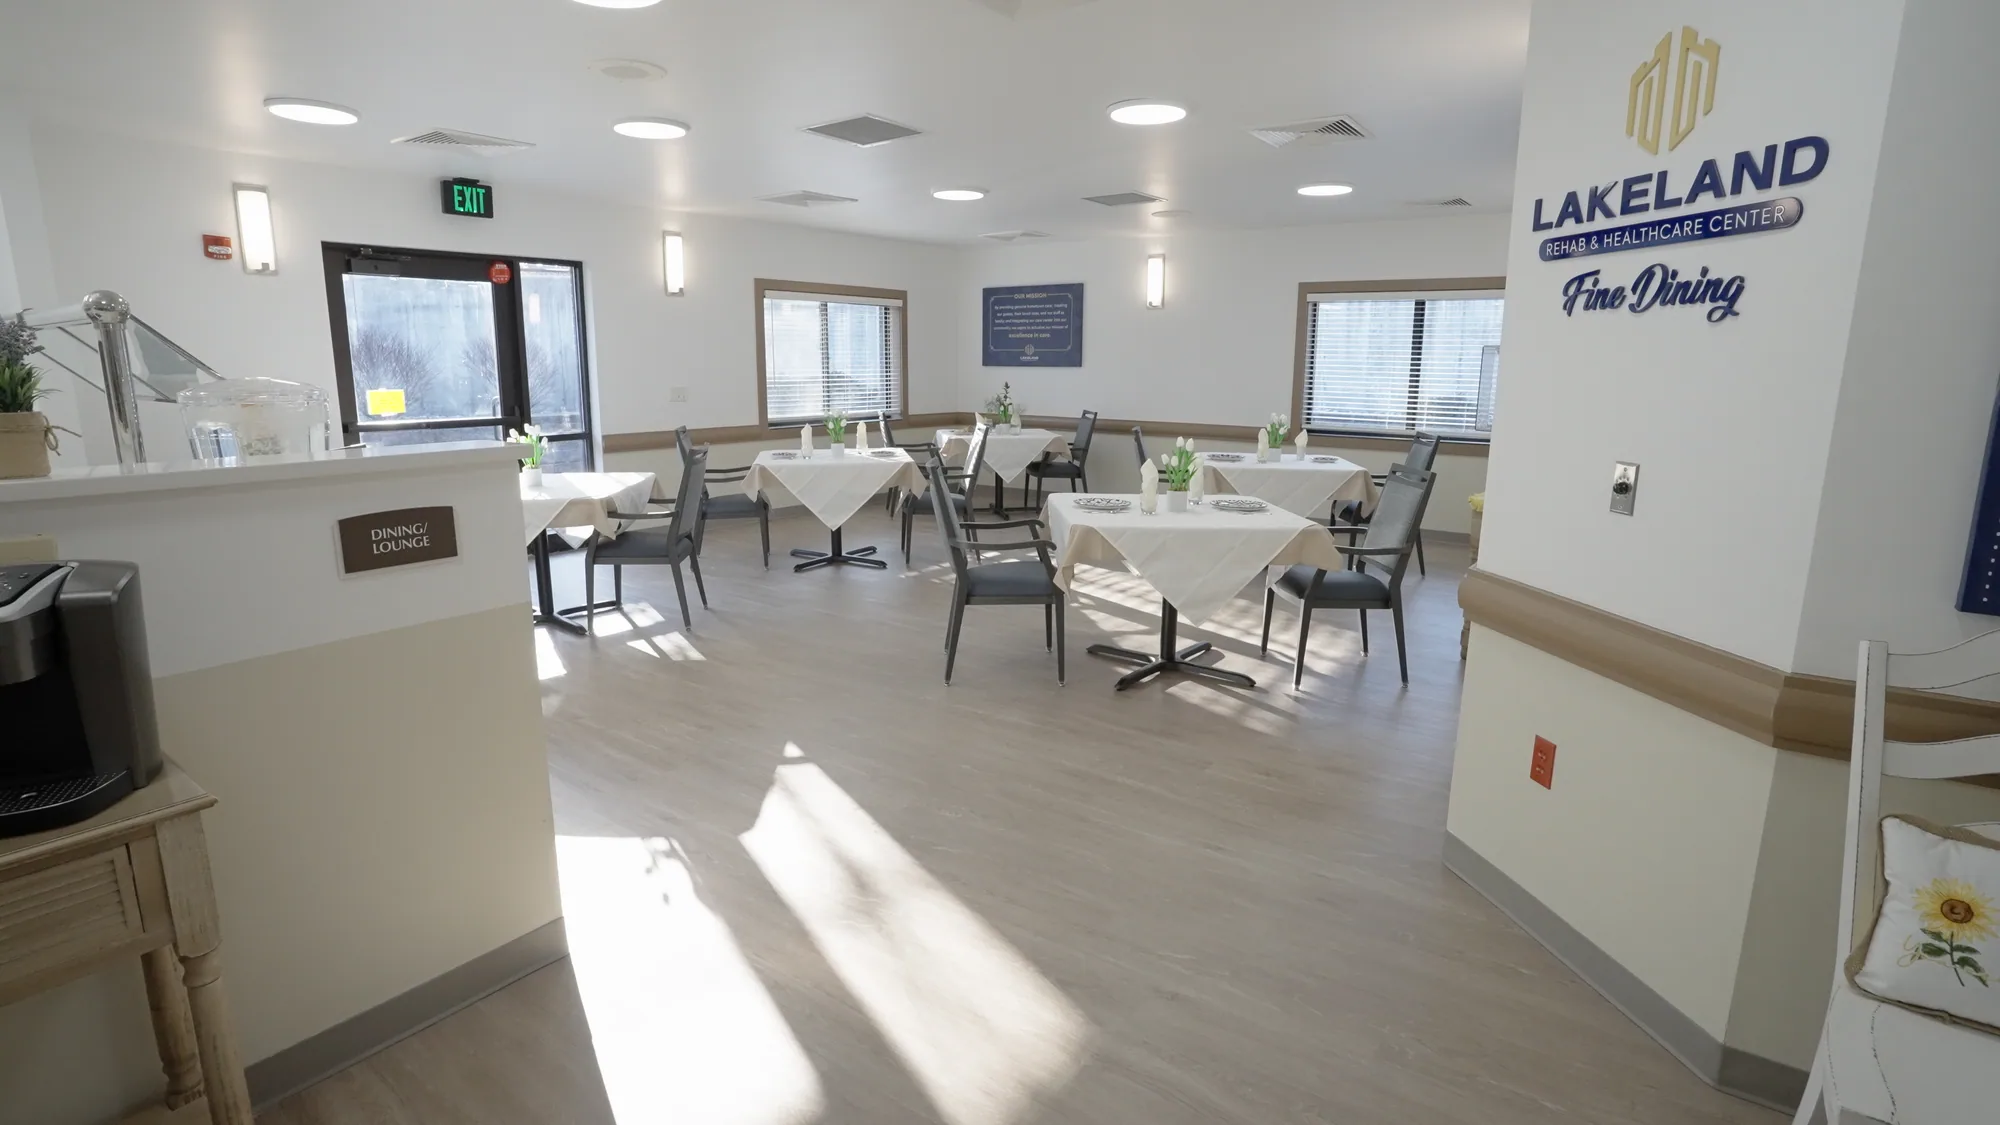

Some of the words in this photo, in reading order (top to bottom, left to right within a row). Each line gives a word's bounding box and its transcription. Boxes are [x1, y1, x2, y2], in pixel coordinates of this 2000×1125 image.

[453, 184, 486, 215] EXIT
[1532, 135, 1830, 233] LAKELAND
[1545, 238, 1587, 257] REHAB
[1589, 236, 1599, 250] &
[1603, 218, 1704, 248] HEALTHCARE
[1708, 204, 1786, 233] CENTER
[1562, 268, 1628, 318] Fine
[1628, 262, 1746, 323] Dining
[371, 522, 428, 541] DINING/
[373, 536, 430, 554] LOUNGE
